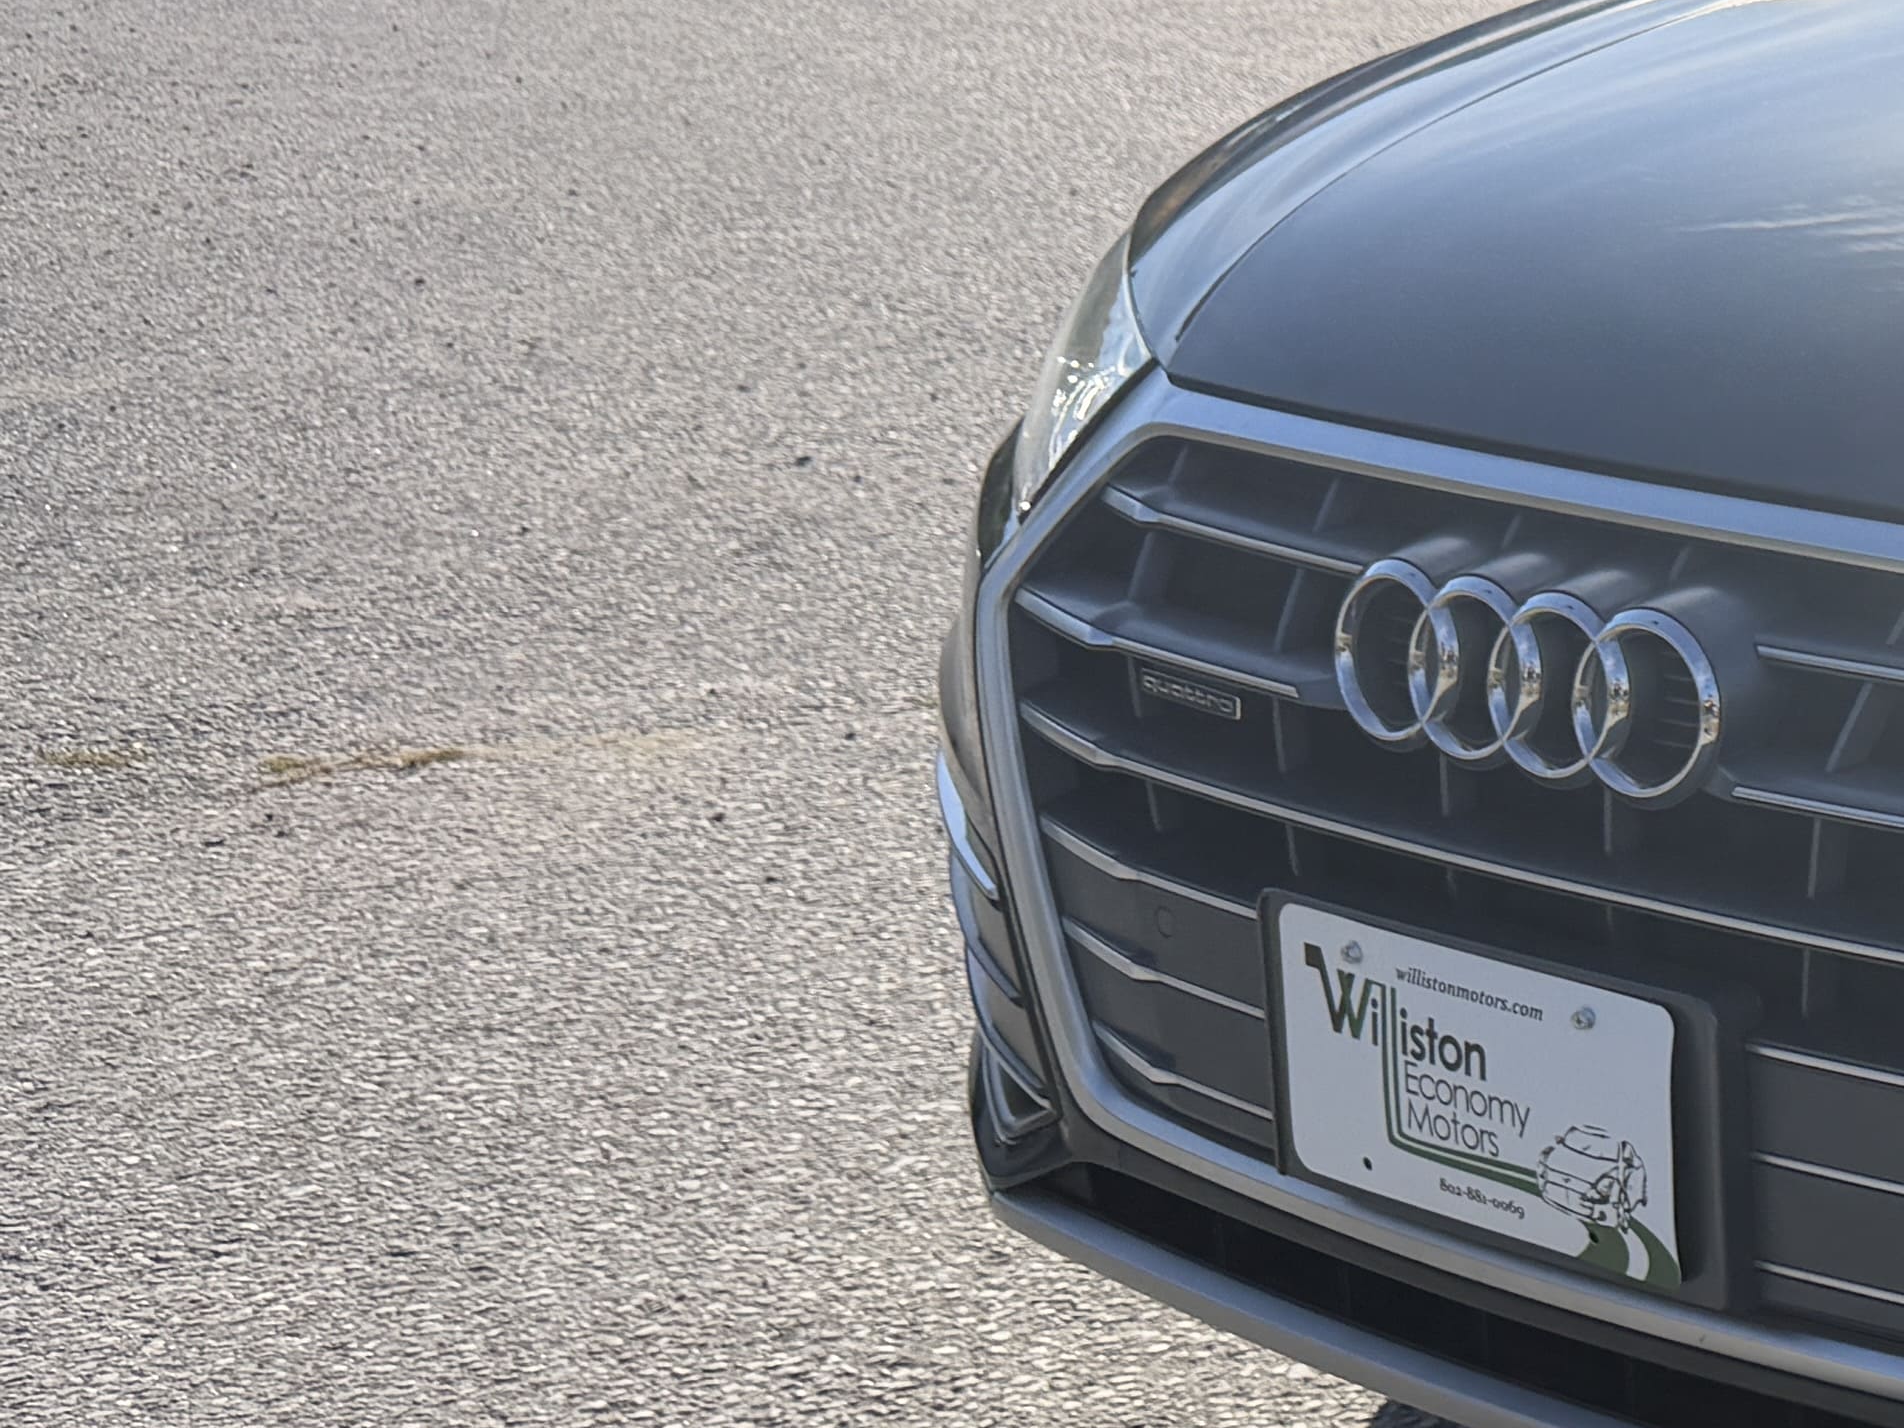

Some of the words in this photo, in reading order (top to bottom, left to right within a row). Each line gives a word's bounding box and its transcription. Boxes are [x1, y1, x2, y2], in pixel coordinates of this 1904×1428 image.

[1143, 675, 1233, 713] quattro
[1304, 943, 1488, 1082] Williston
[1395, 967, 1544, 1021] willistonmotors.com
[1405, 1060, 1530, 1138] Economy
[1408, 1098, 1501, 1158] Motors
[1439, 1177, 1526, 1221] 802-881-0069
